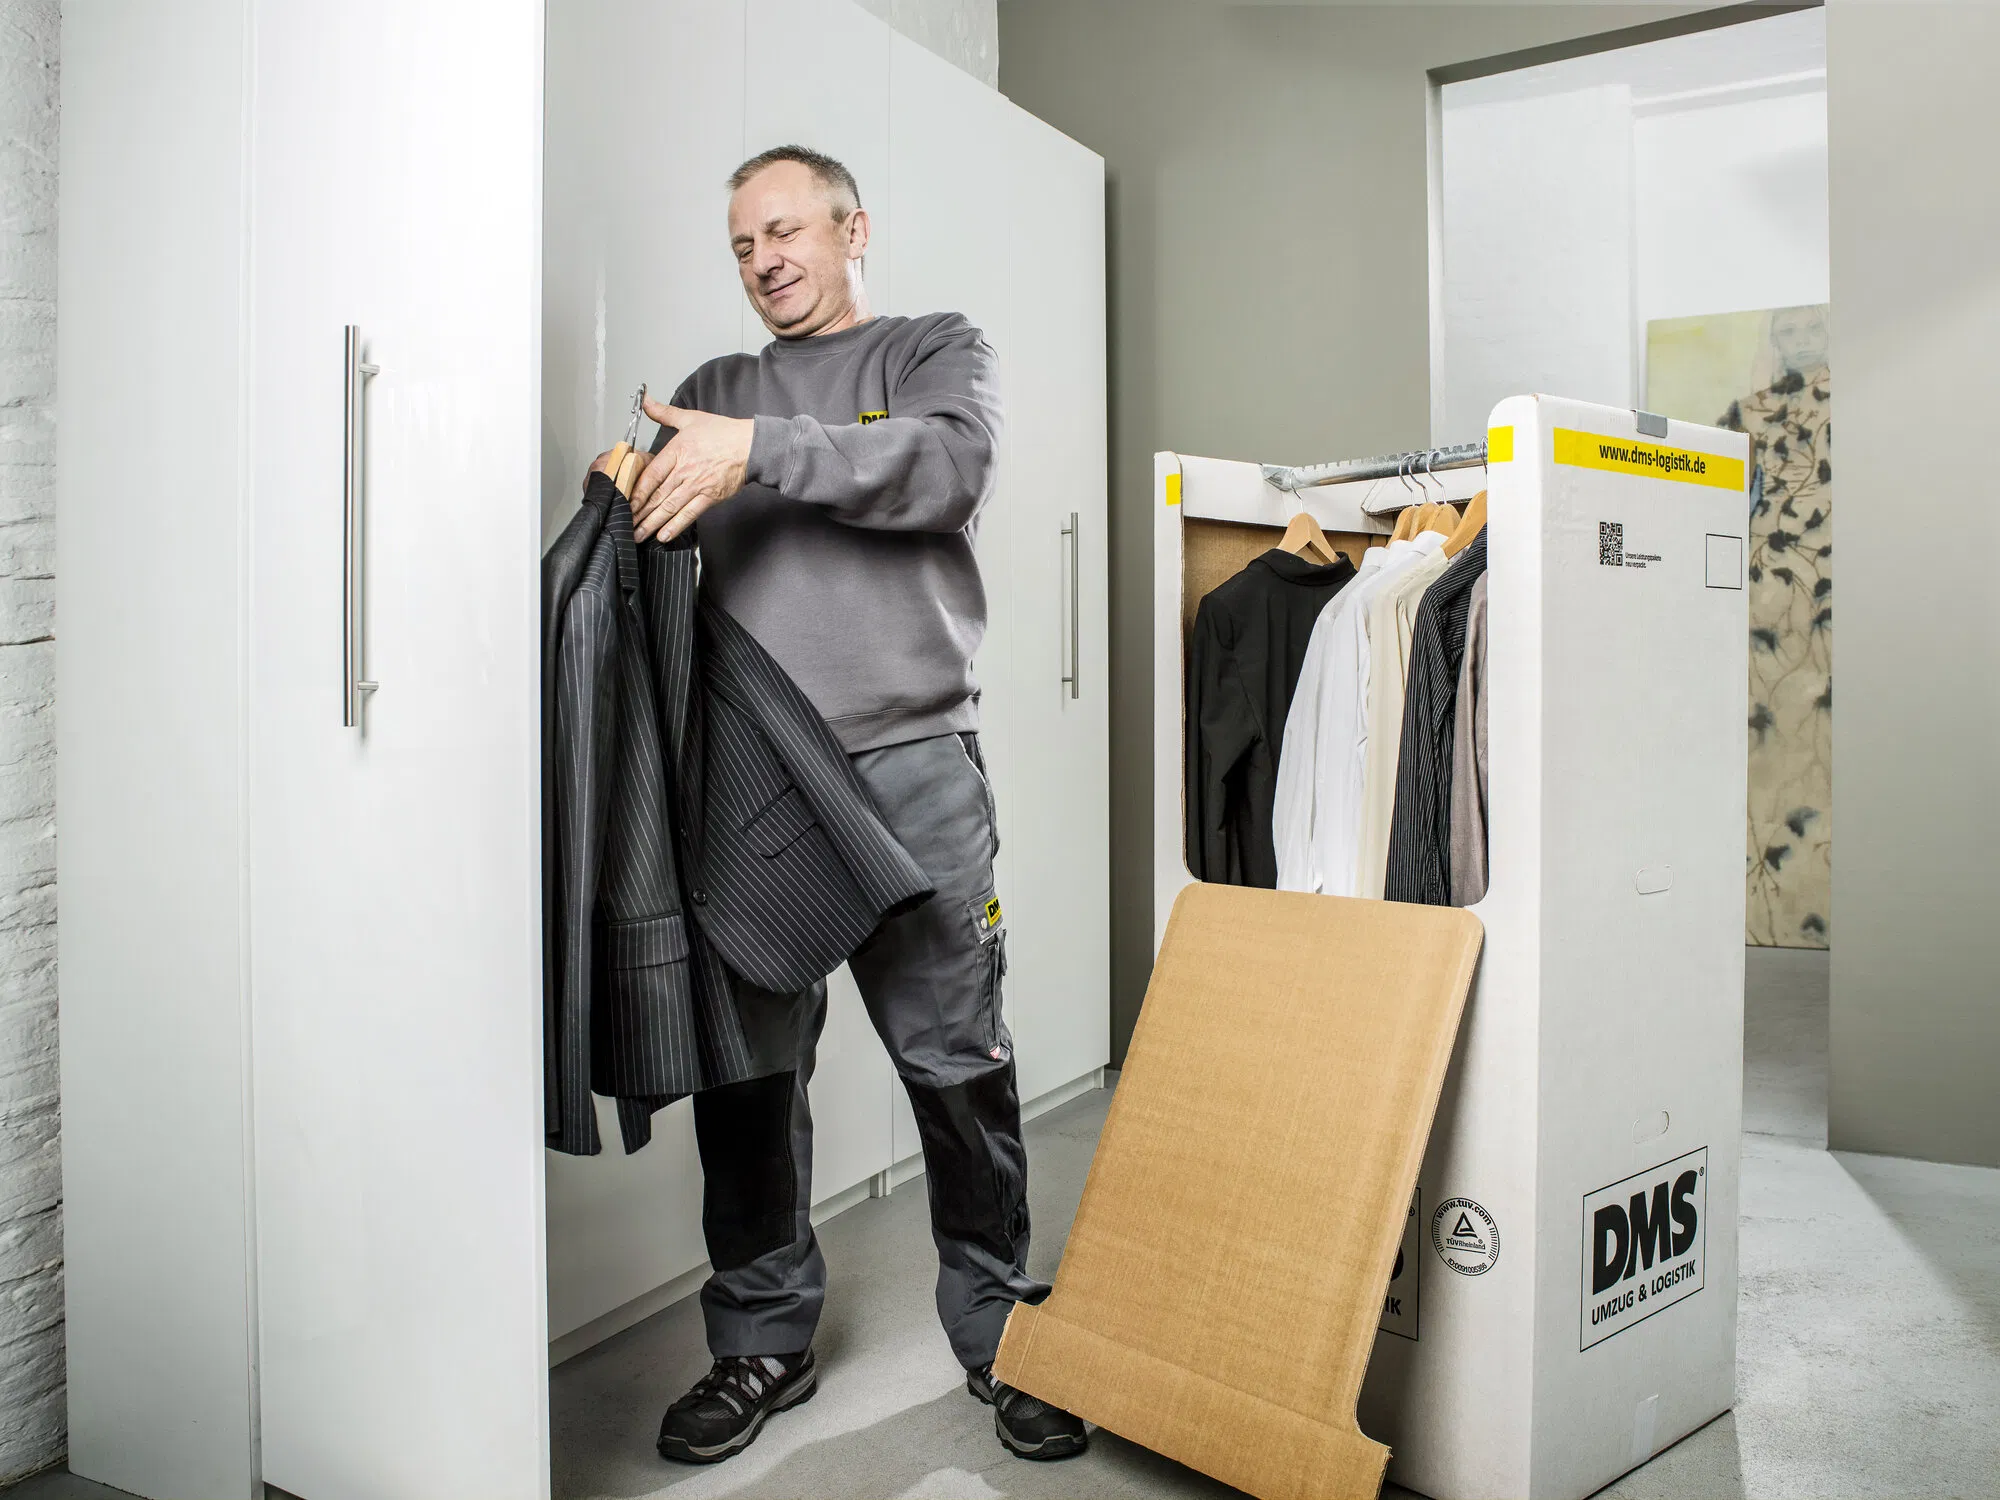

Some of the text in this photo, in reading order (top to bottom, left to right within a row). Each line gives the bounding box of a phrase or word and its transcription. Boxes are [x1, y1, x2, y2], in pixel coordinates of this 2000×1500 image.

[1599, 444, 1706, 474] www.dms-logistik.de
[1437, 1199, 1492, 1225] www.tuv.com
[1593, 1170, 1698, 1295] DMS
[1591, 1259, 1697, 1326] UMZUG & LOGISTIK
